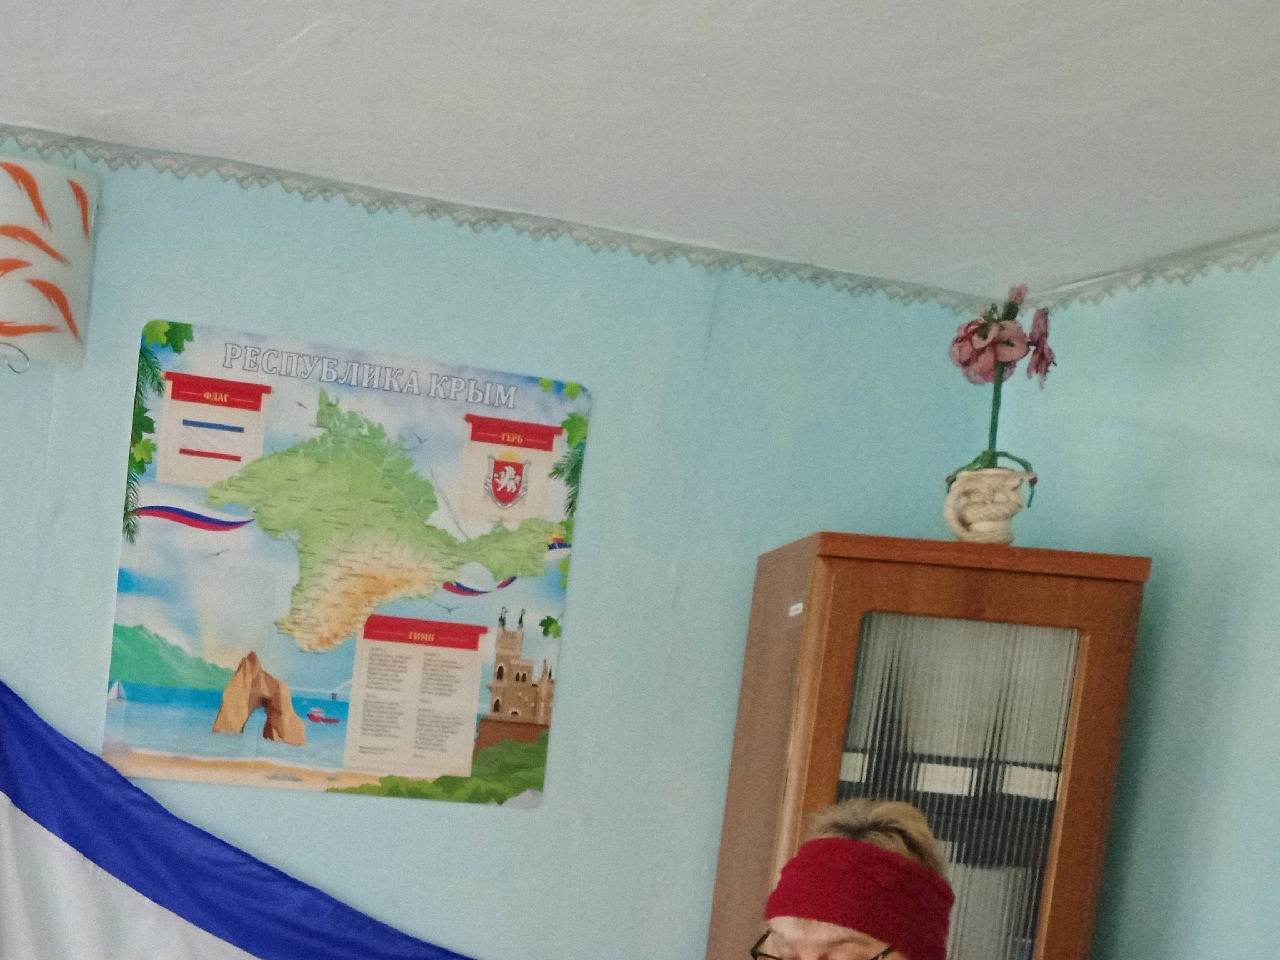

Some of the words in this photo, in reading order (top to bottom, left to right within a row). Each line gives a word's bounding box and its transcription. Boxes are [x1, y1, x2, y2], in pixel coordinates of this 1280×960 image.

[223, 342, 421, 396] РЕСПУБЛИКА
[428, 372, 518, 409] КРЫМ
[203, 391, 229, 402] ФЛАГ
[502, 432, 523, 443] ГЕРБ
[408, 631, 434, 642] ГИМН
